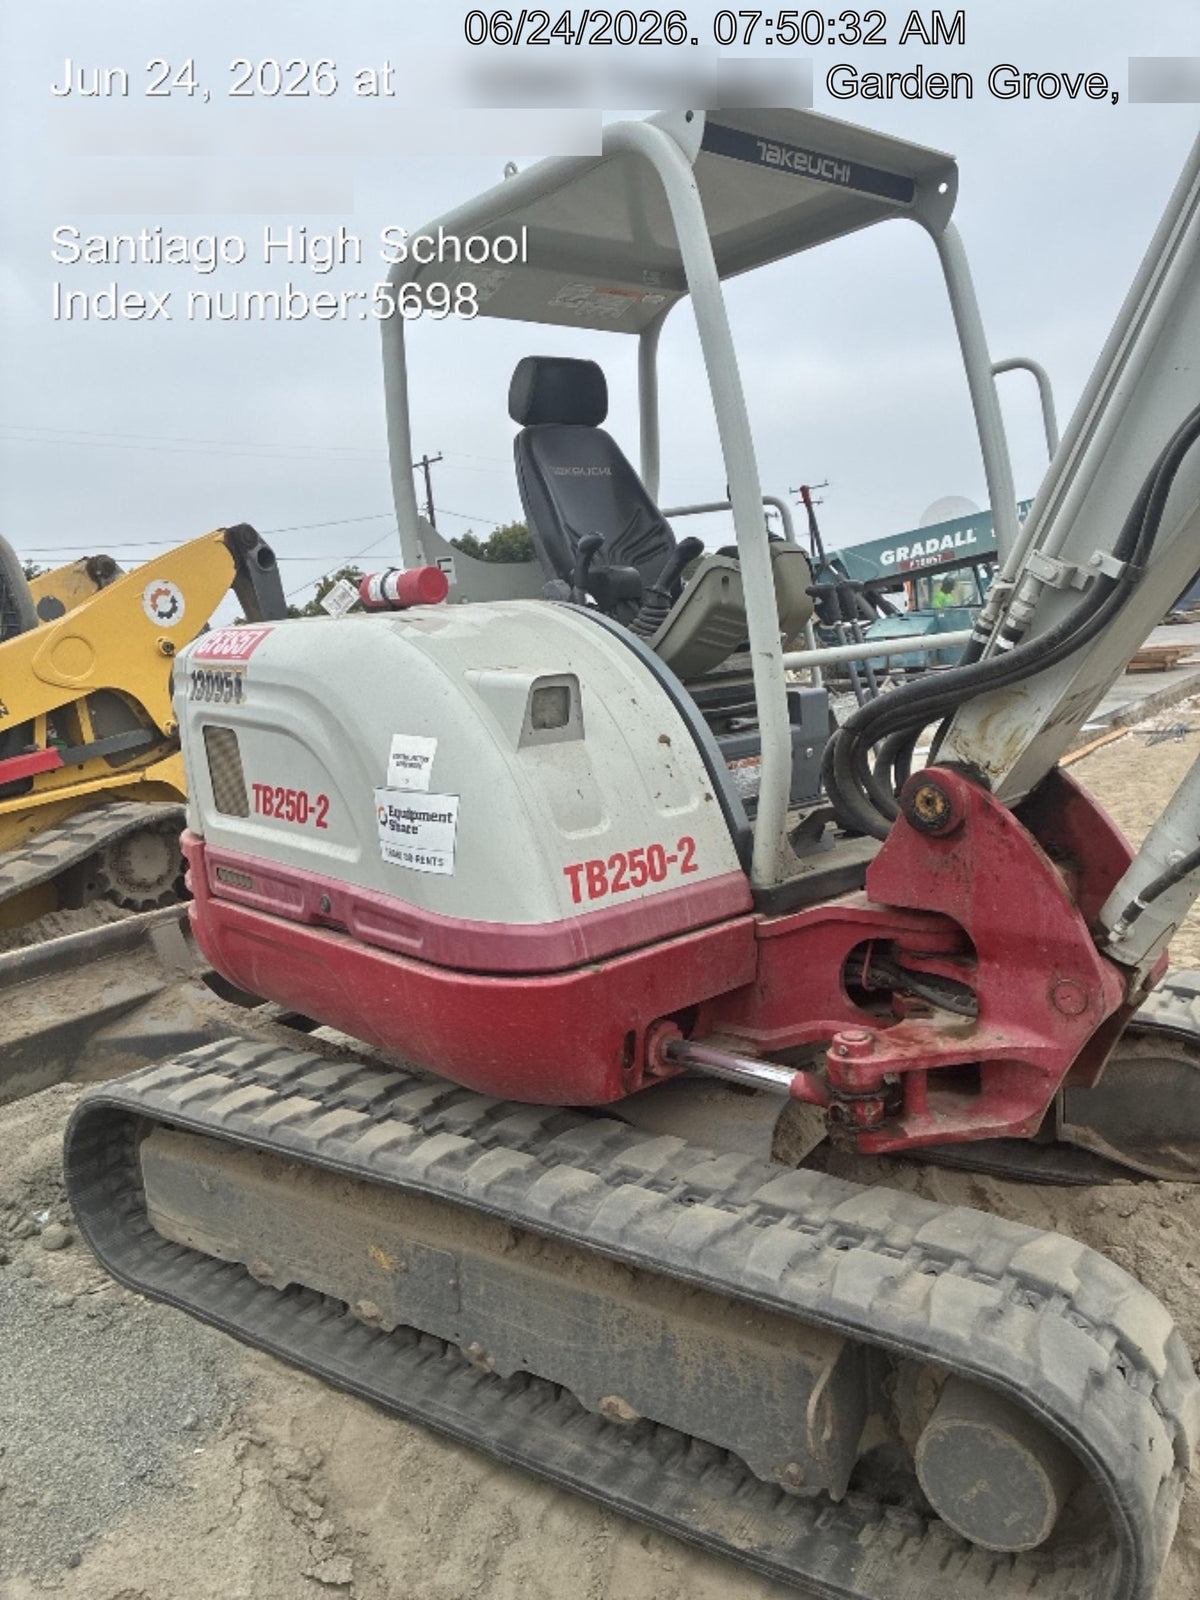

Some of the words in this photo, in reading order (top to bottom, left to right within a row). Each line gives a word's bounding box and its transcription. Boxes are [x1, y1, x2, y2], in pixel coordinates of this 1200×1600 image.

[880, 527, 977, 566] GRADALL
[252, 783, 330, 830] TB250-2
[387, 805, 454, 825] Equipment
[563, 836, 699, 904] TB250-2
